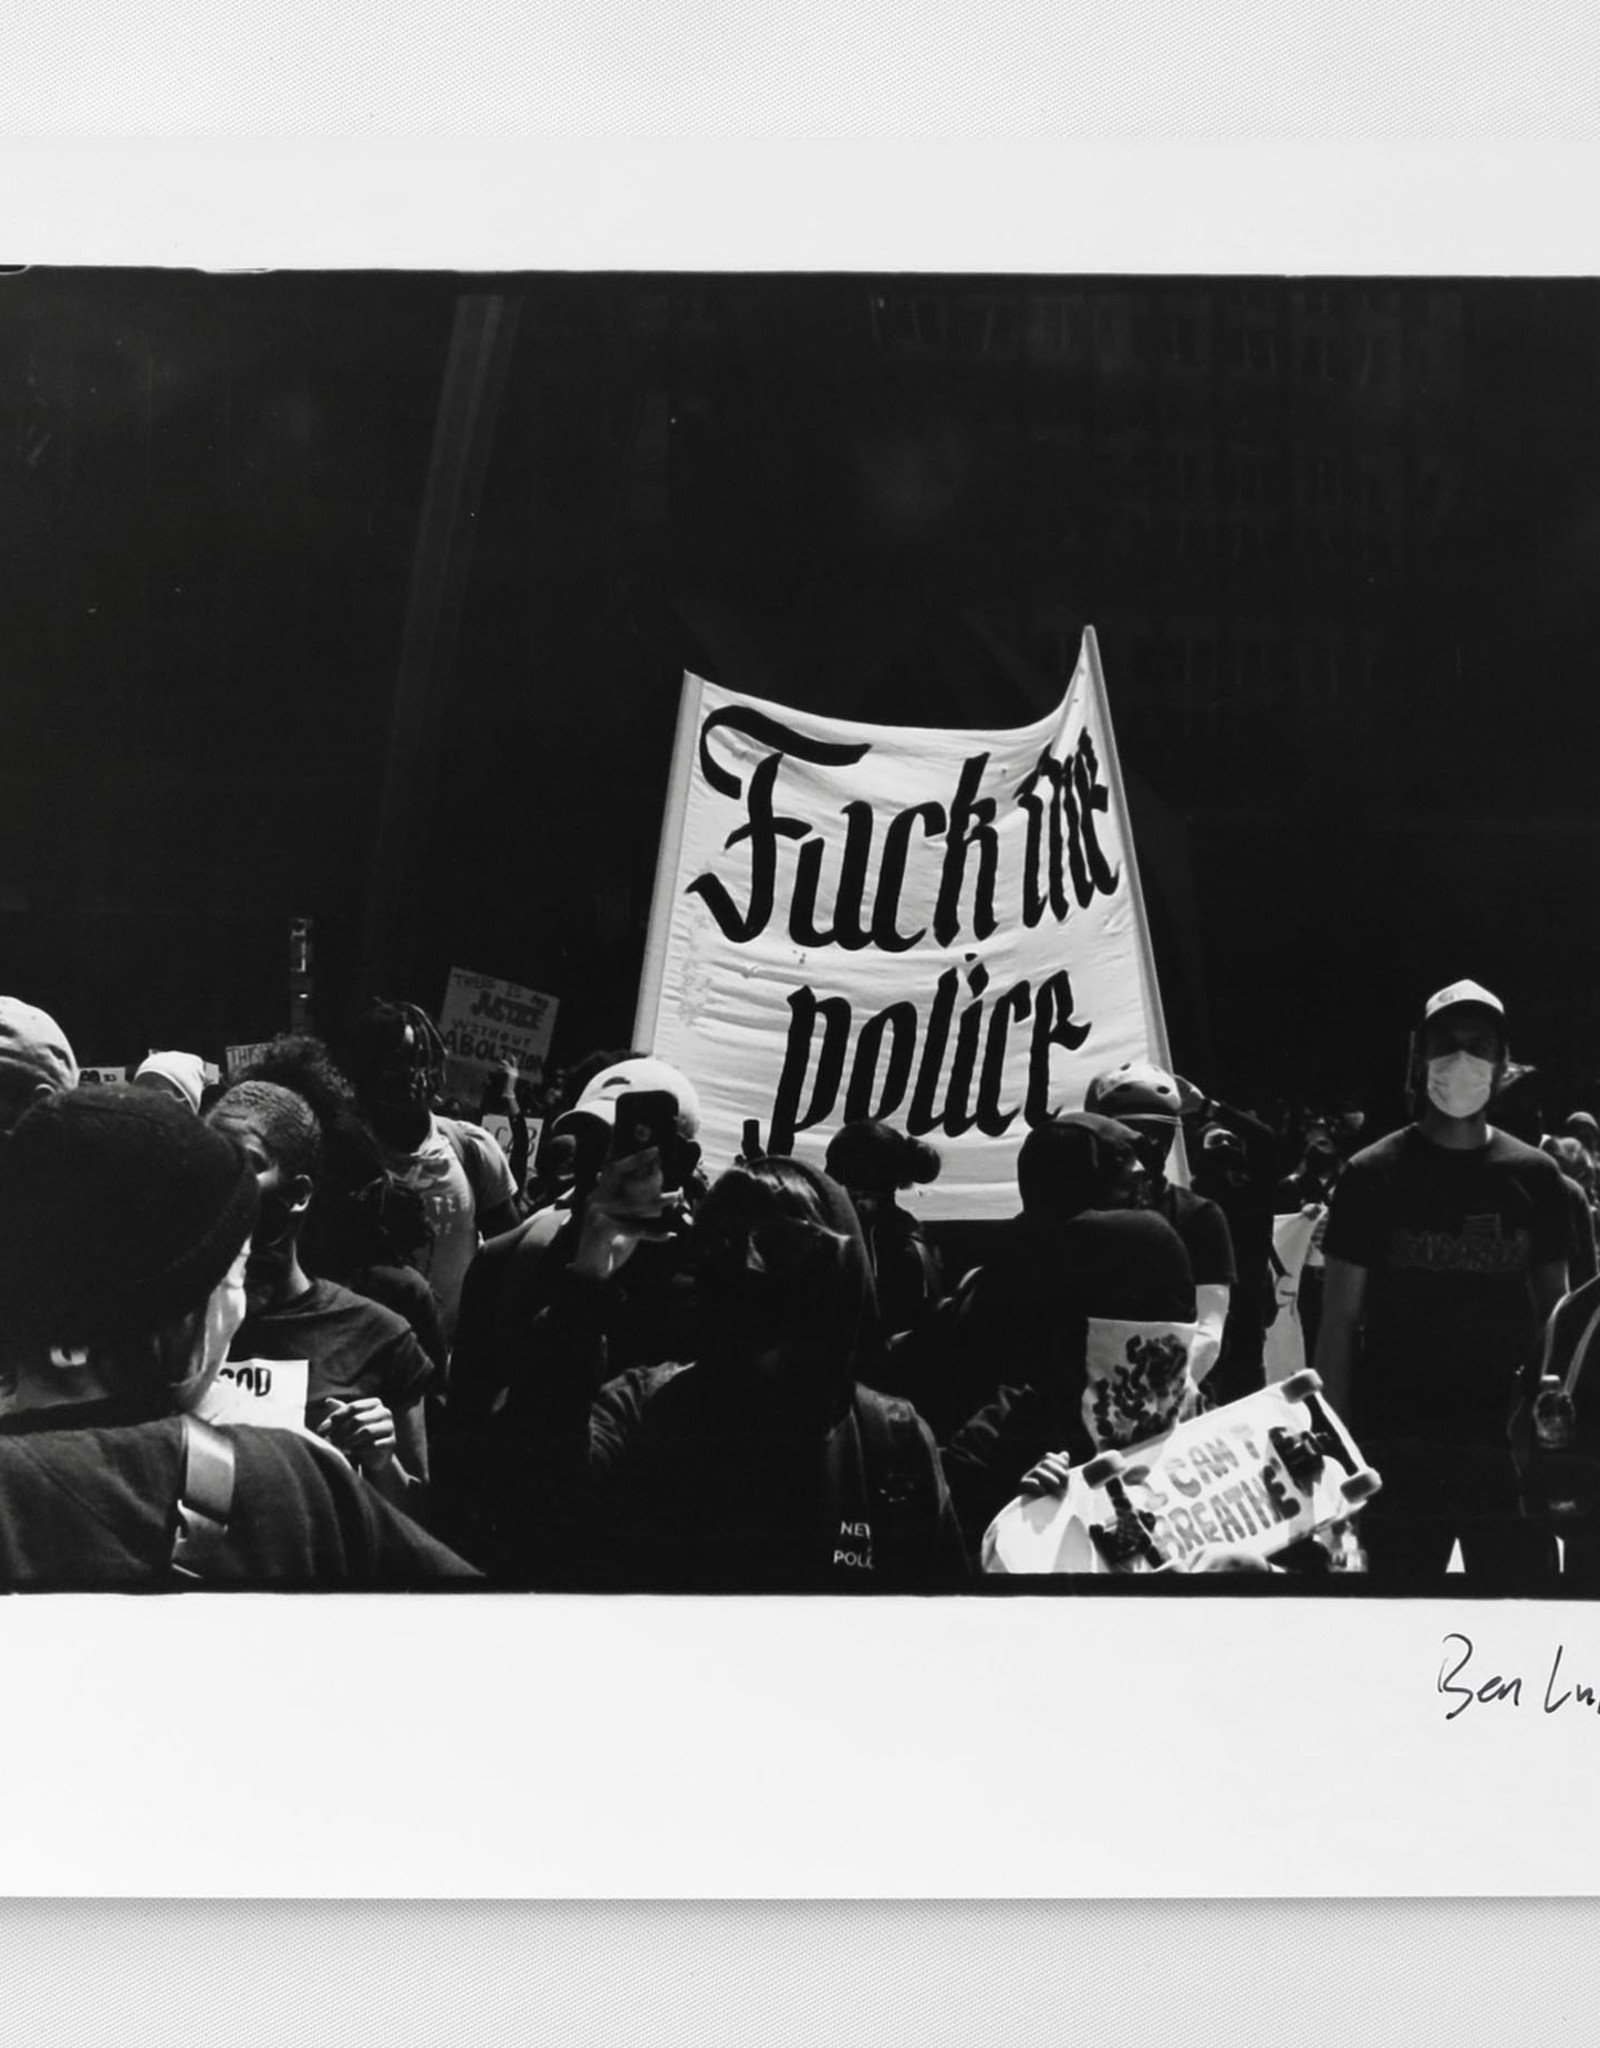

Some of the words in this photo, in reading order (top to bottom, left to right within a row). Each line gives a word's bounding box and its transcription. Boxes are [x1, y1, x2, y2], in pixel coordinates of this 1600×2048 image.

[685, 704, 999, 952] Fuck
[766, 952, 1092, 1157] police
[1438, 1633, 1522, 1720] Ben
